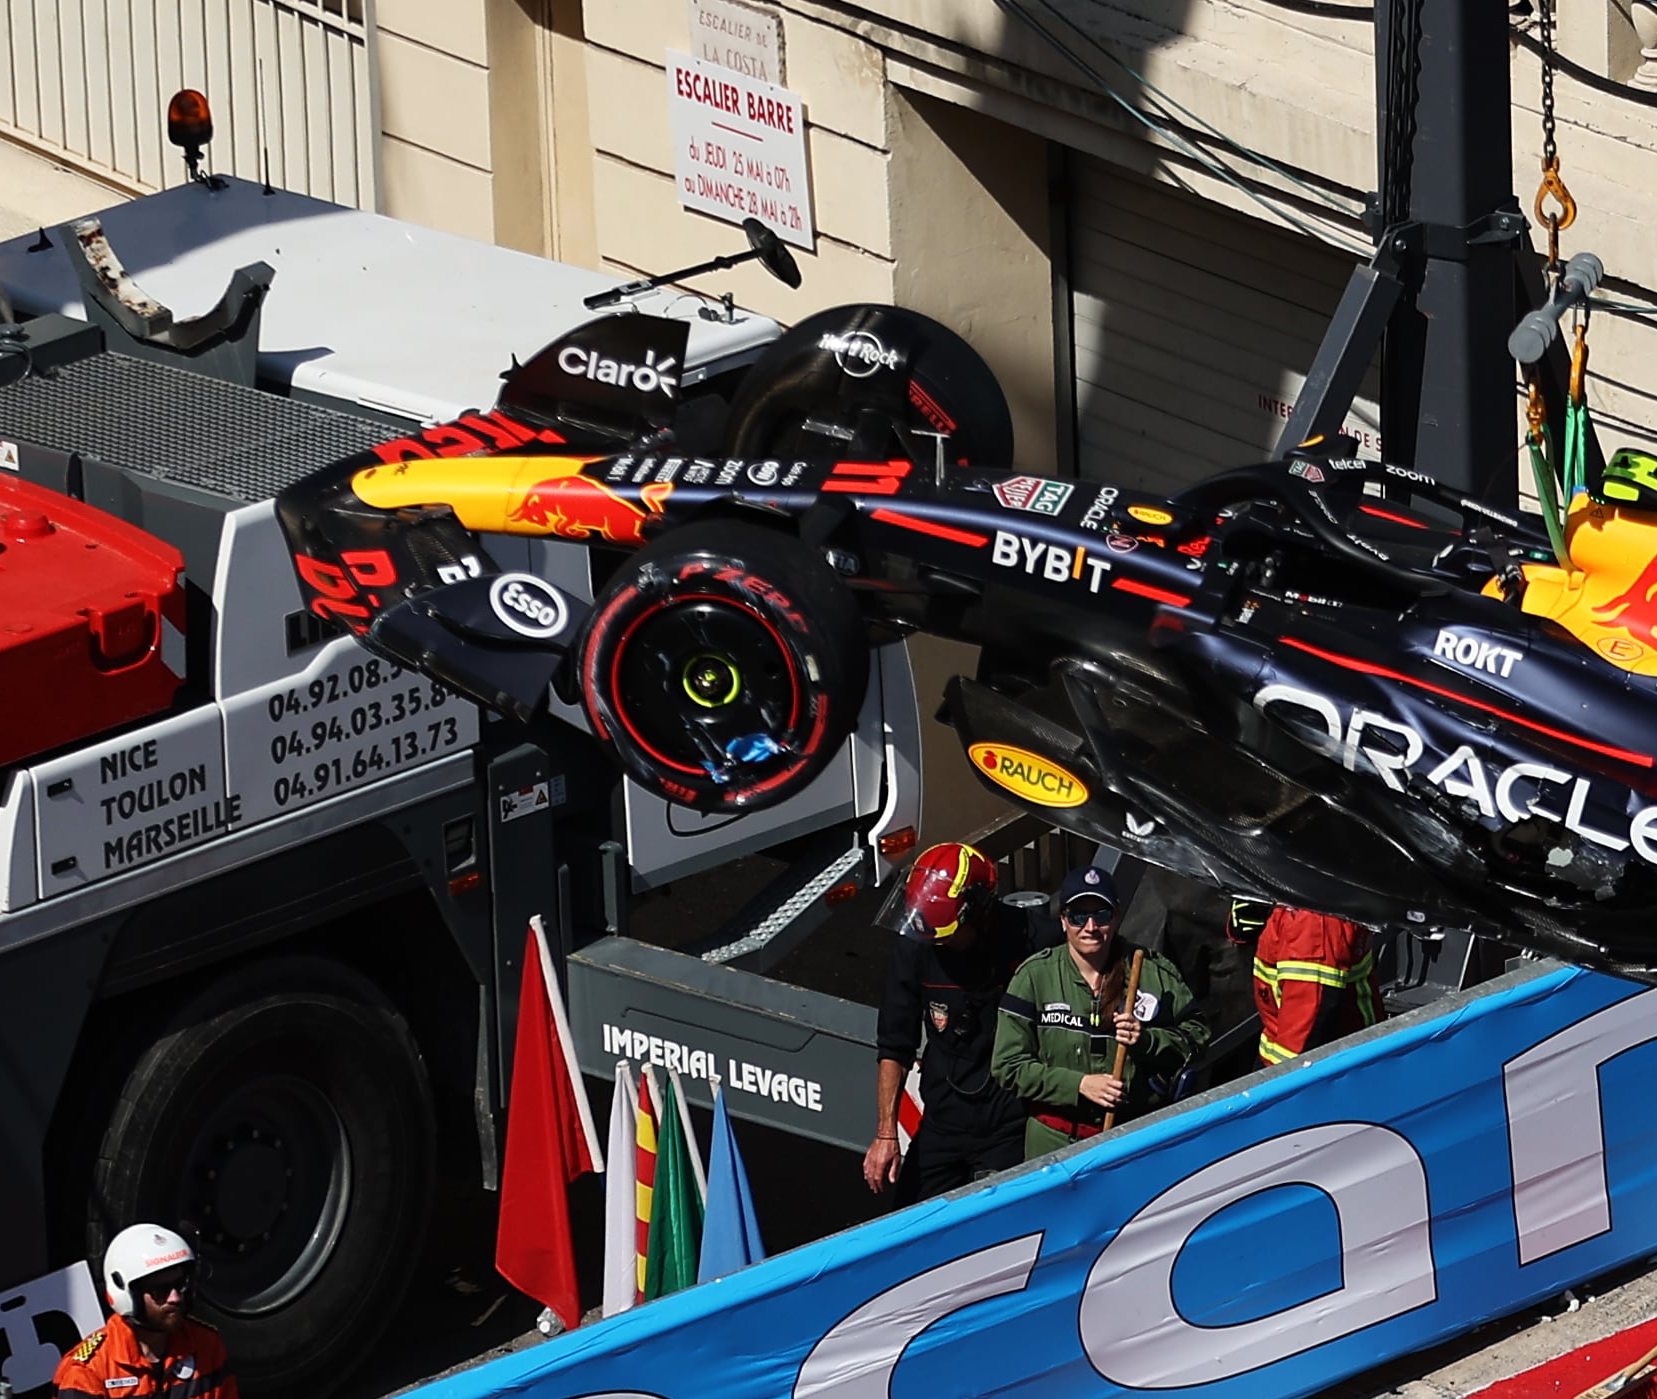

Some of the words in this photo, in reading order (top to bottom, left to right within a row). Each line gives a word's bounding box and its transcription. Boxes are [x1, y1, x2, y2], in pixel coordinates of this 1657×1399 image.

[699, 10, 752, 40] ESCALIER
[756, 33, 768, 48] DE
[703, 43, 720, 63] LA
[726, 49, 768, 81] COSTA
[676, 68, 741, 116] ESCALIER
[747, 91, 794, 134] BARRE
[689, 136, 700, 160] du
[704, 141, 726, 169] JEUDI
[733, 151, 743, 176] 25
[747, 158, 764, 182] MAI
[774, 165, 790, 192] 07h
[697, 174, 744, 211] DIMANCHE
[747, 191, 758, 215] 28
[760, 196, 778, 222] MAI
[558, 347, 661, 392] Claro
[858, 344, 898, 370] Rock
[1328, 459, 1367, 470] telcel
[1385, 464, 1435, 486] zoom
[1034, 482, 1065, 513] TAG
[1080, 487, 1119, 530] ORACLE
[992, 530, 1111, 594] BYBIT
[501, 581, 556, 627] Esso
[1433, 629, 1523, 679] ROKT
[99, 739, 158, 785] NICE
[274, 716, 459, 807] 04.91.64.13.73
[999, 756, 1074, 799] RAUCH
[100, 764, 207, 826] TOULON
[103, 793, 243, 870] MARSEILLE
[1041, 1012, 1084, 1028] MEDICAL
[603, 1023, 722, 1082] IMPERIAL
[729, 1058, 823, 1112] LEVAGE
